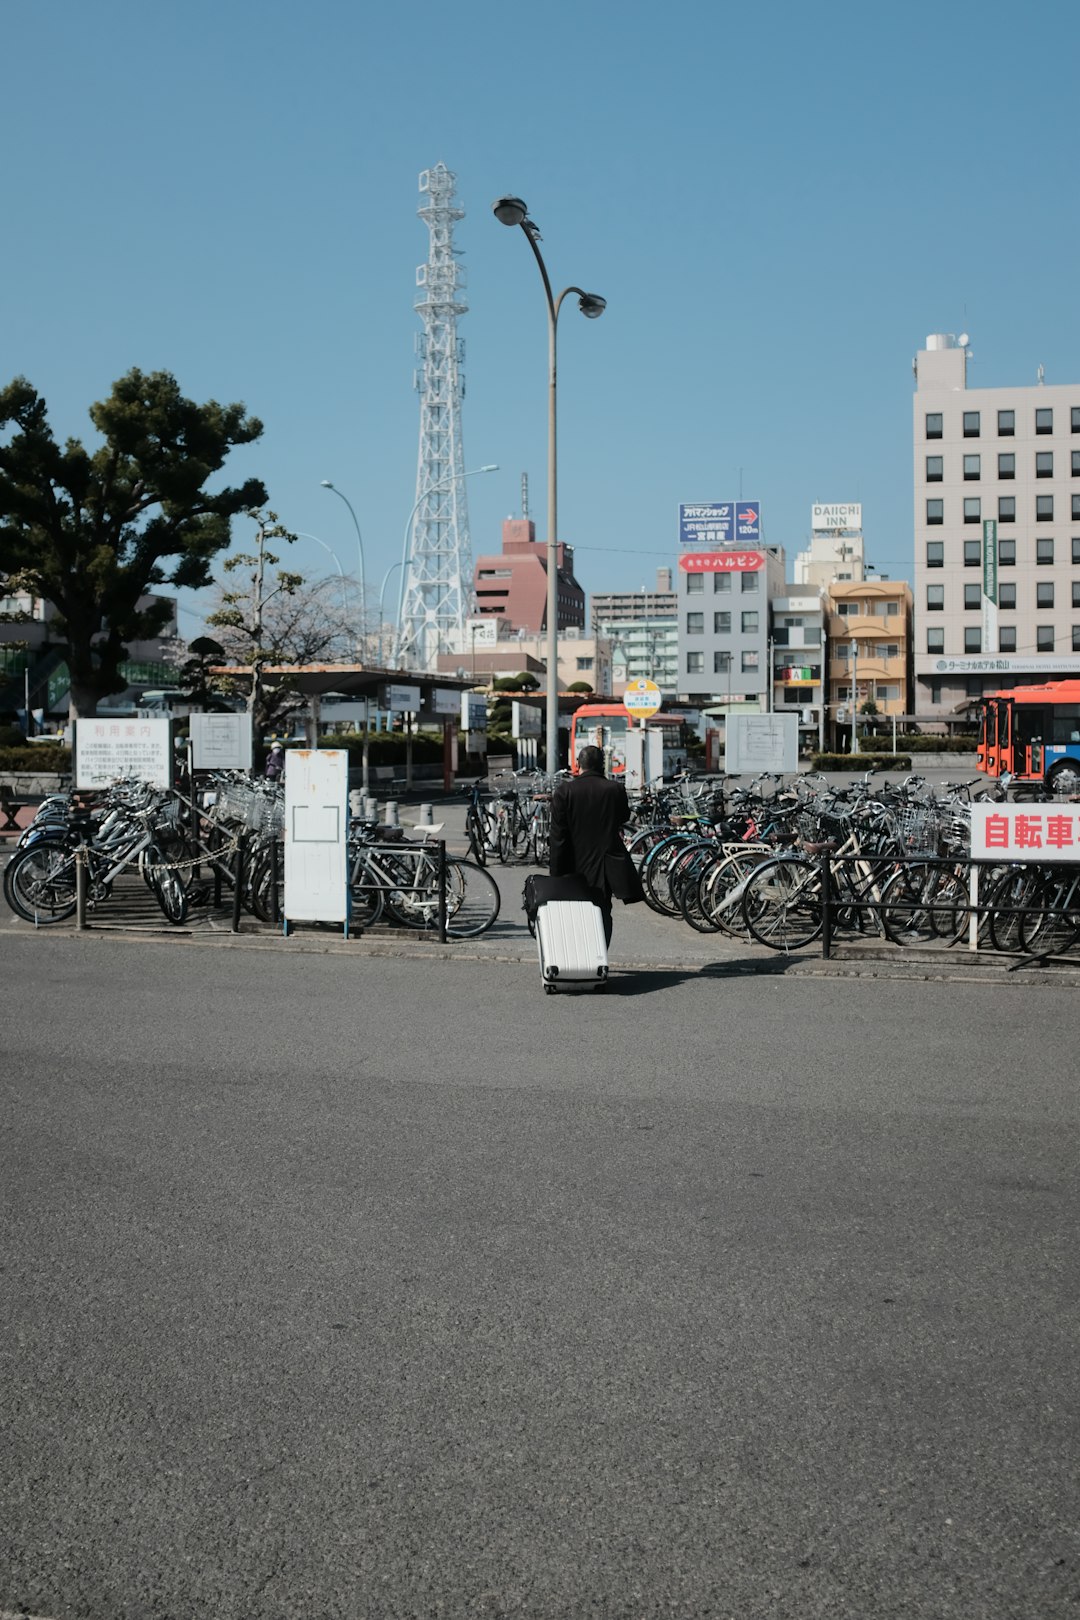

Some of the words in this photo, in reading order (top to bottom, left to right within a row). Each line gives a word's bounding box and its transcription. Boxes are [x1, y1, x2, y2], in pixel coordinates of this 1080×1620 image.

[814, 506, 860, 516] DAIICHI
[826, 516, 847, 526] INN
[738, 525, 758, 535] 120m
[95, 725, 151, 737] 利用案内
[985, 813, 1080, 849] 自転車
